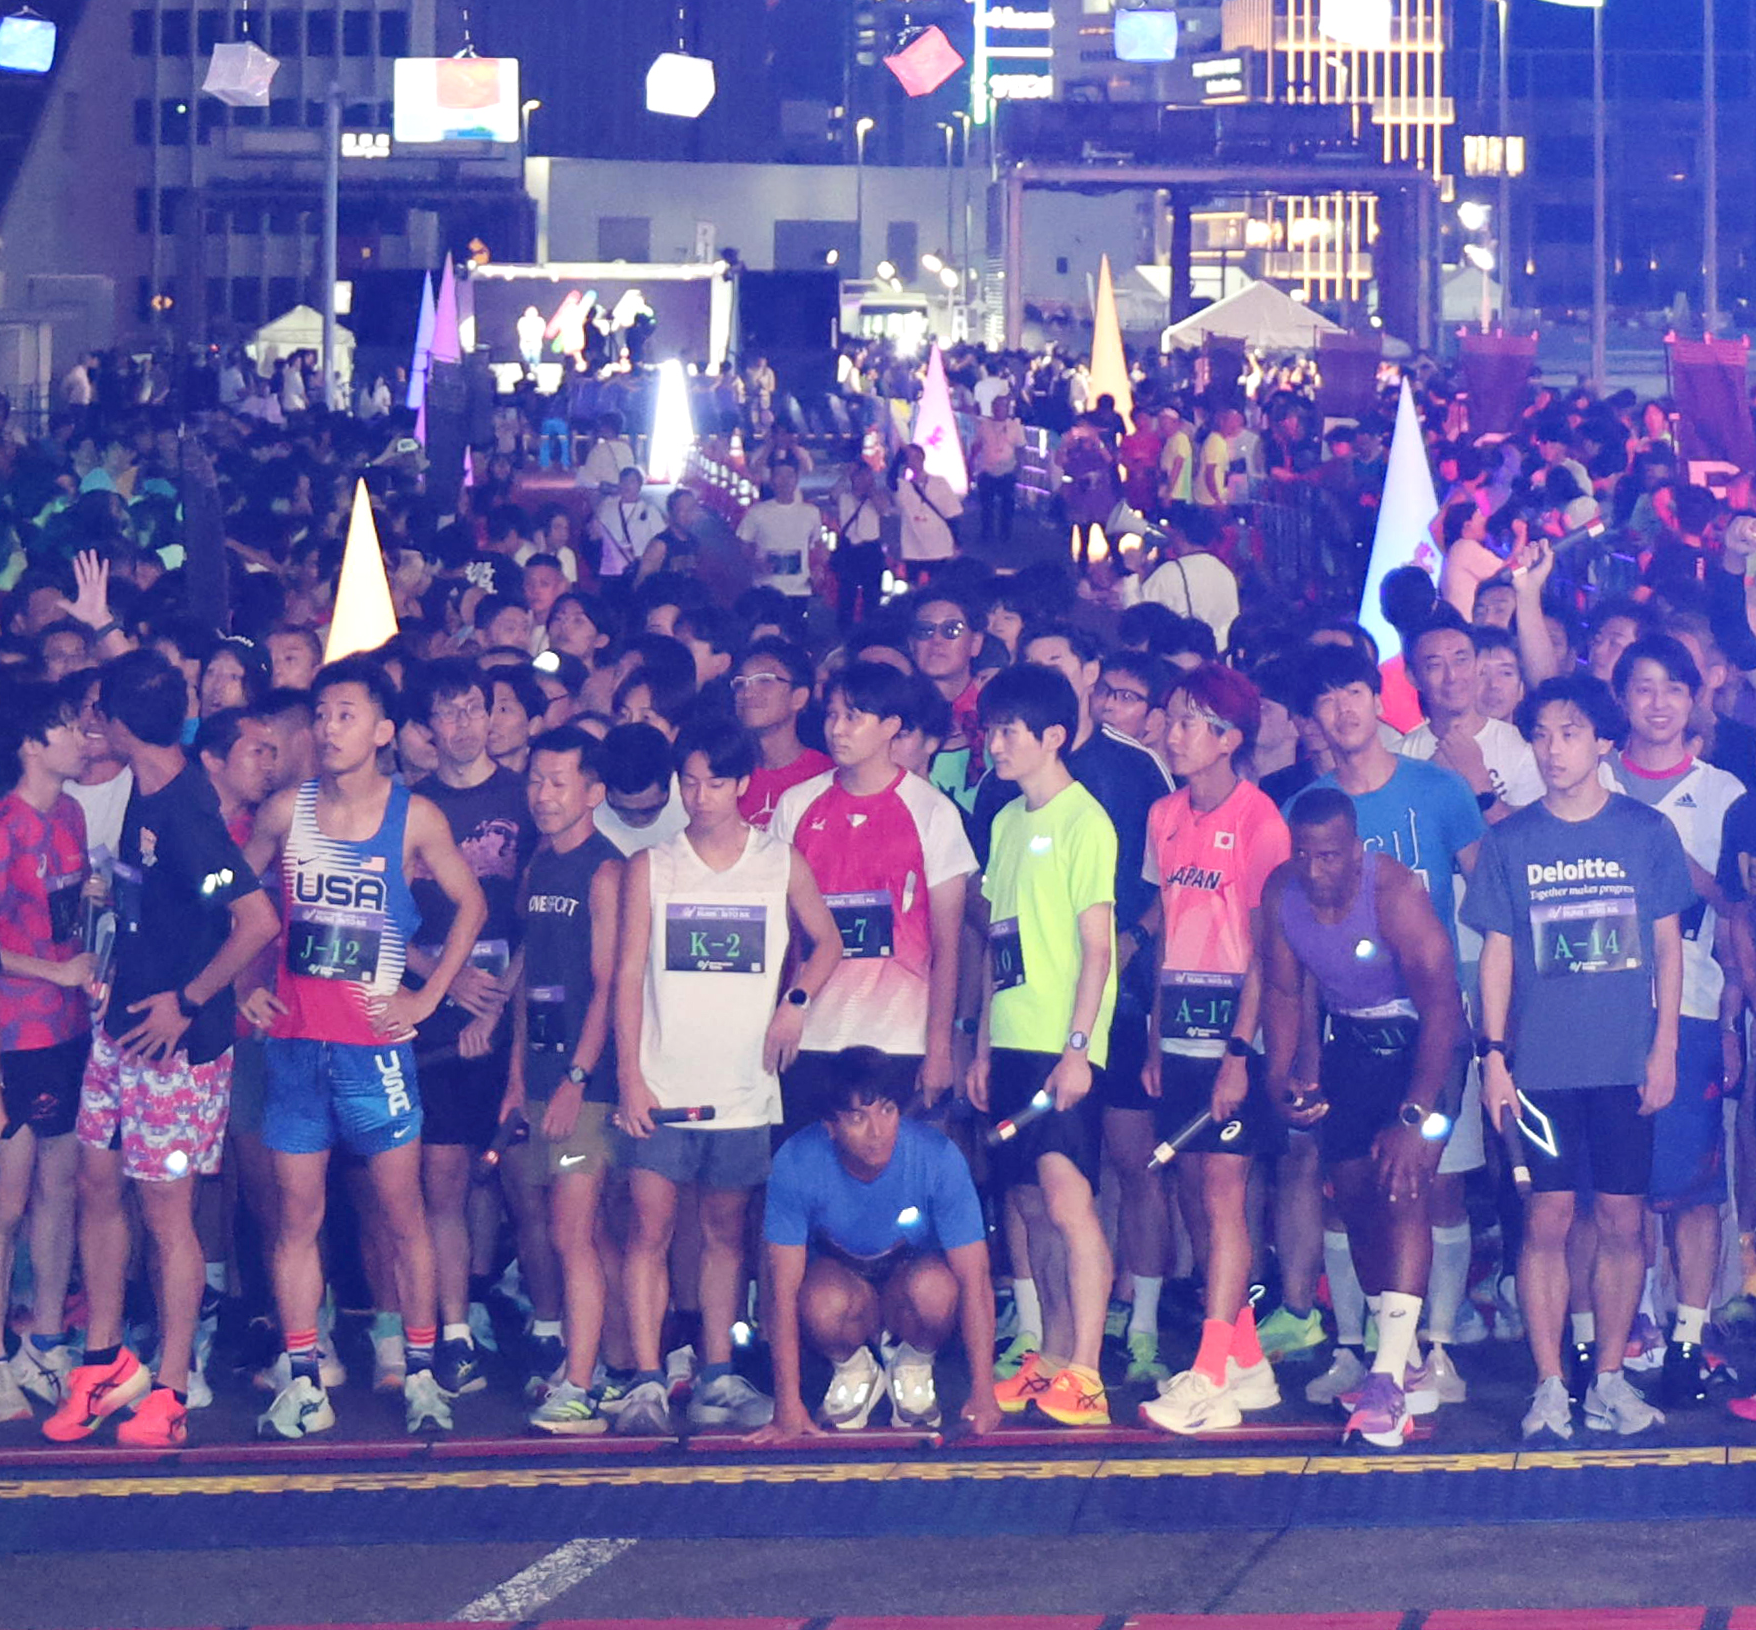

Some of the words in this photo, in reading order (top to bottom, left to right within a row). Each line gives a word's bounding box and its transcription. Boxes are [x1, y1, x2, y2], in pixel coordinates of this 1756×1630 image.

[1166, 864, 1222, 890] JAPAN
[1526, 857, 1627, 886] Deloitte.
[295, 871, 386, 912] USA
[299, 935, 361, 966] J-12
[689, 931, 741, 958] K-2
[1553, 929, 1620, 960] A-14
[1175, 997, 1232, 1025] A-17
[374, 1050, 411, 1117] USA
